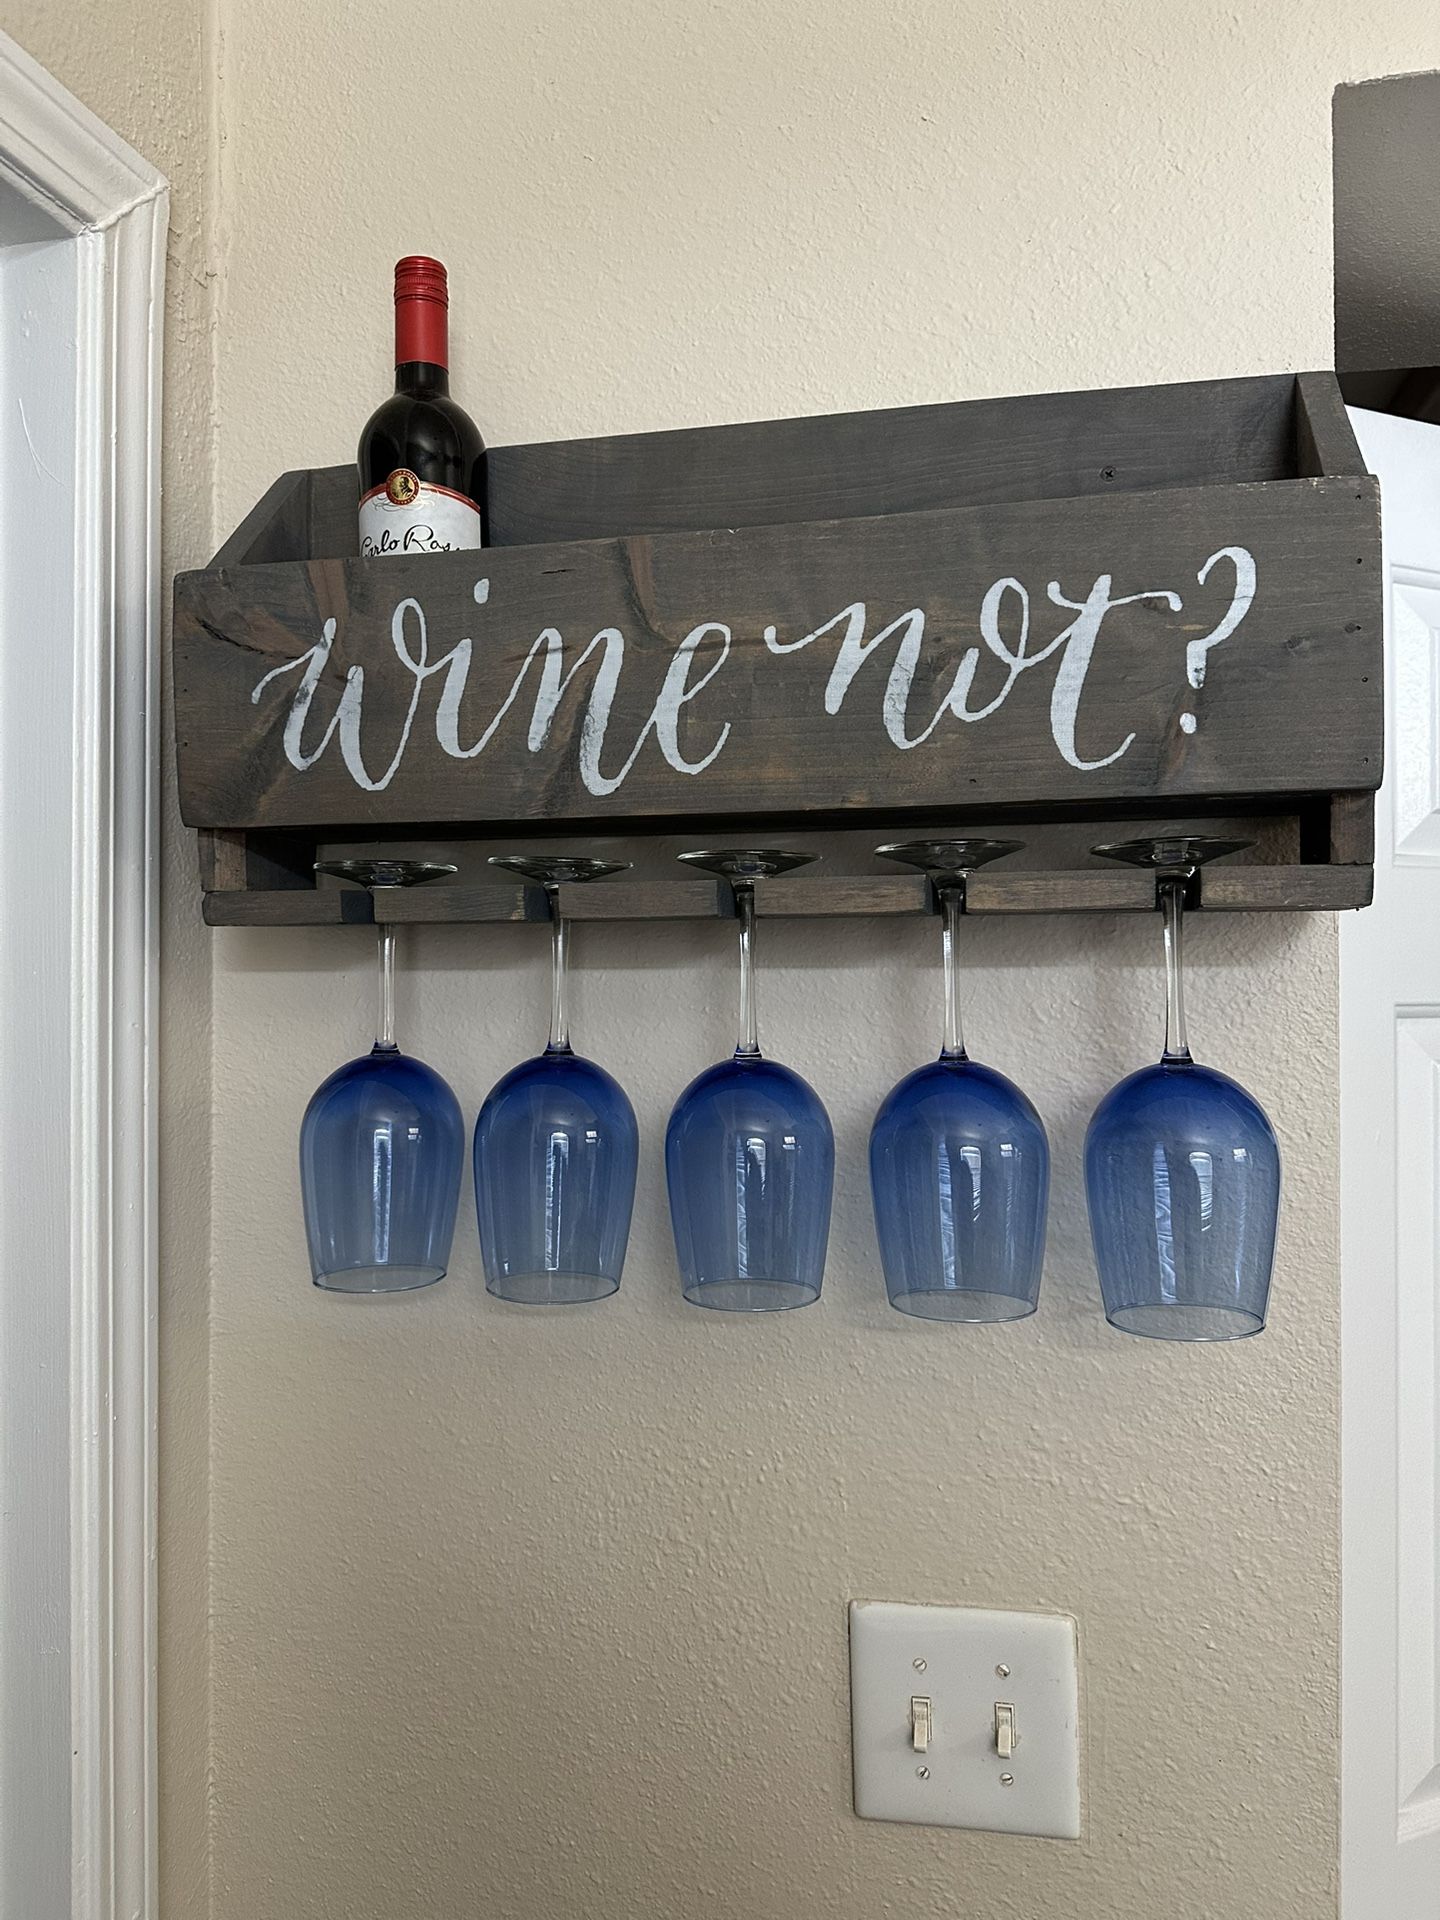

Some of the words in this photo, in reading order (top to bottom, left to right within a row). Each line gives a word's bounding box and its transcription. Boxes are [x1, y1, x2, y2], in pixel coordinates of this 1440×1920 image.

[403, 524, 469, 552] Ros
[251, 578, 732, 796] wine
[764, 546, 1257, 771] not?
